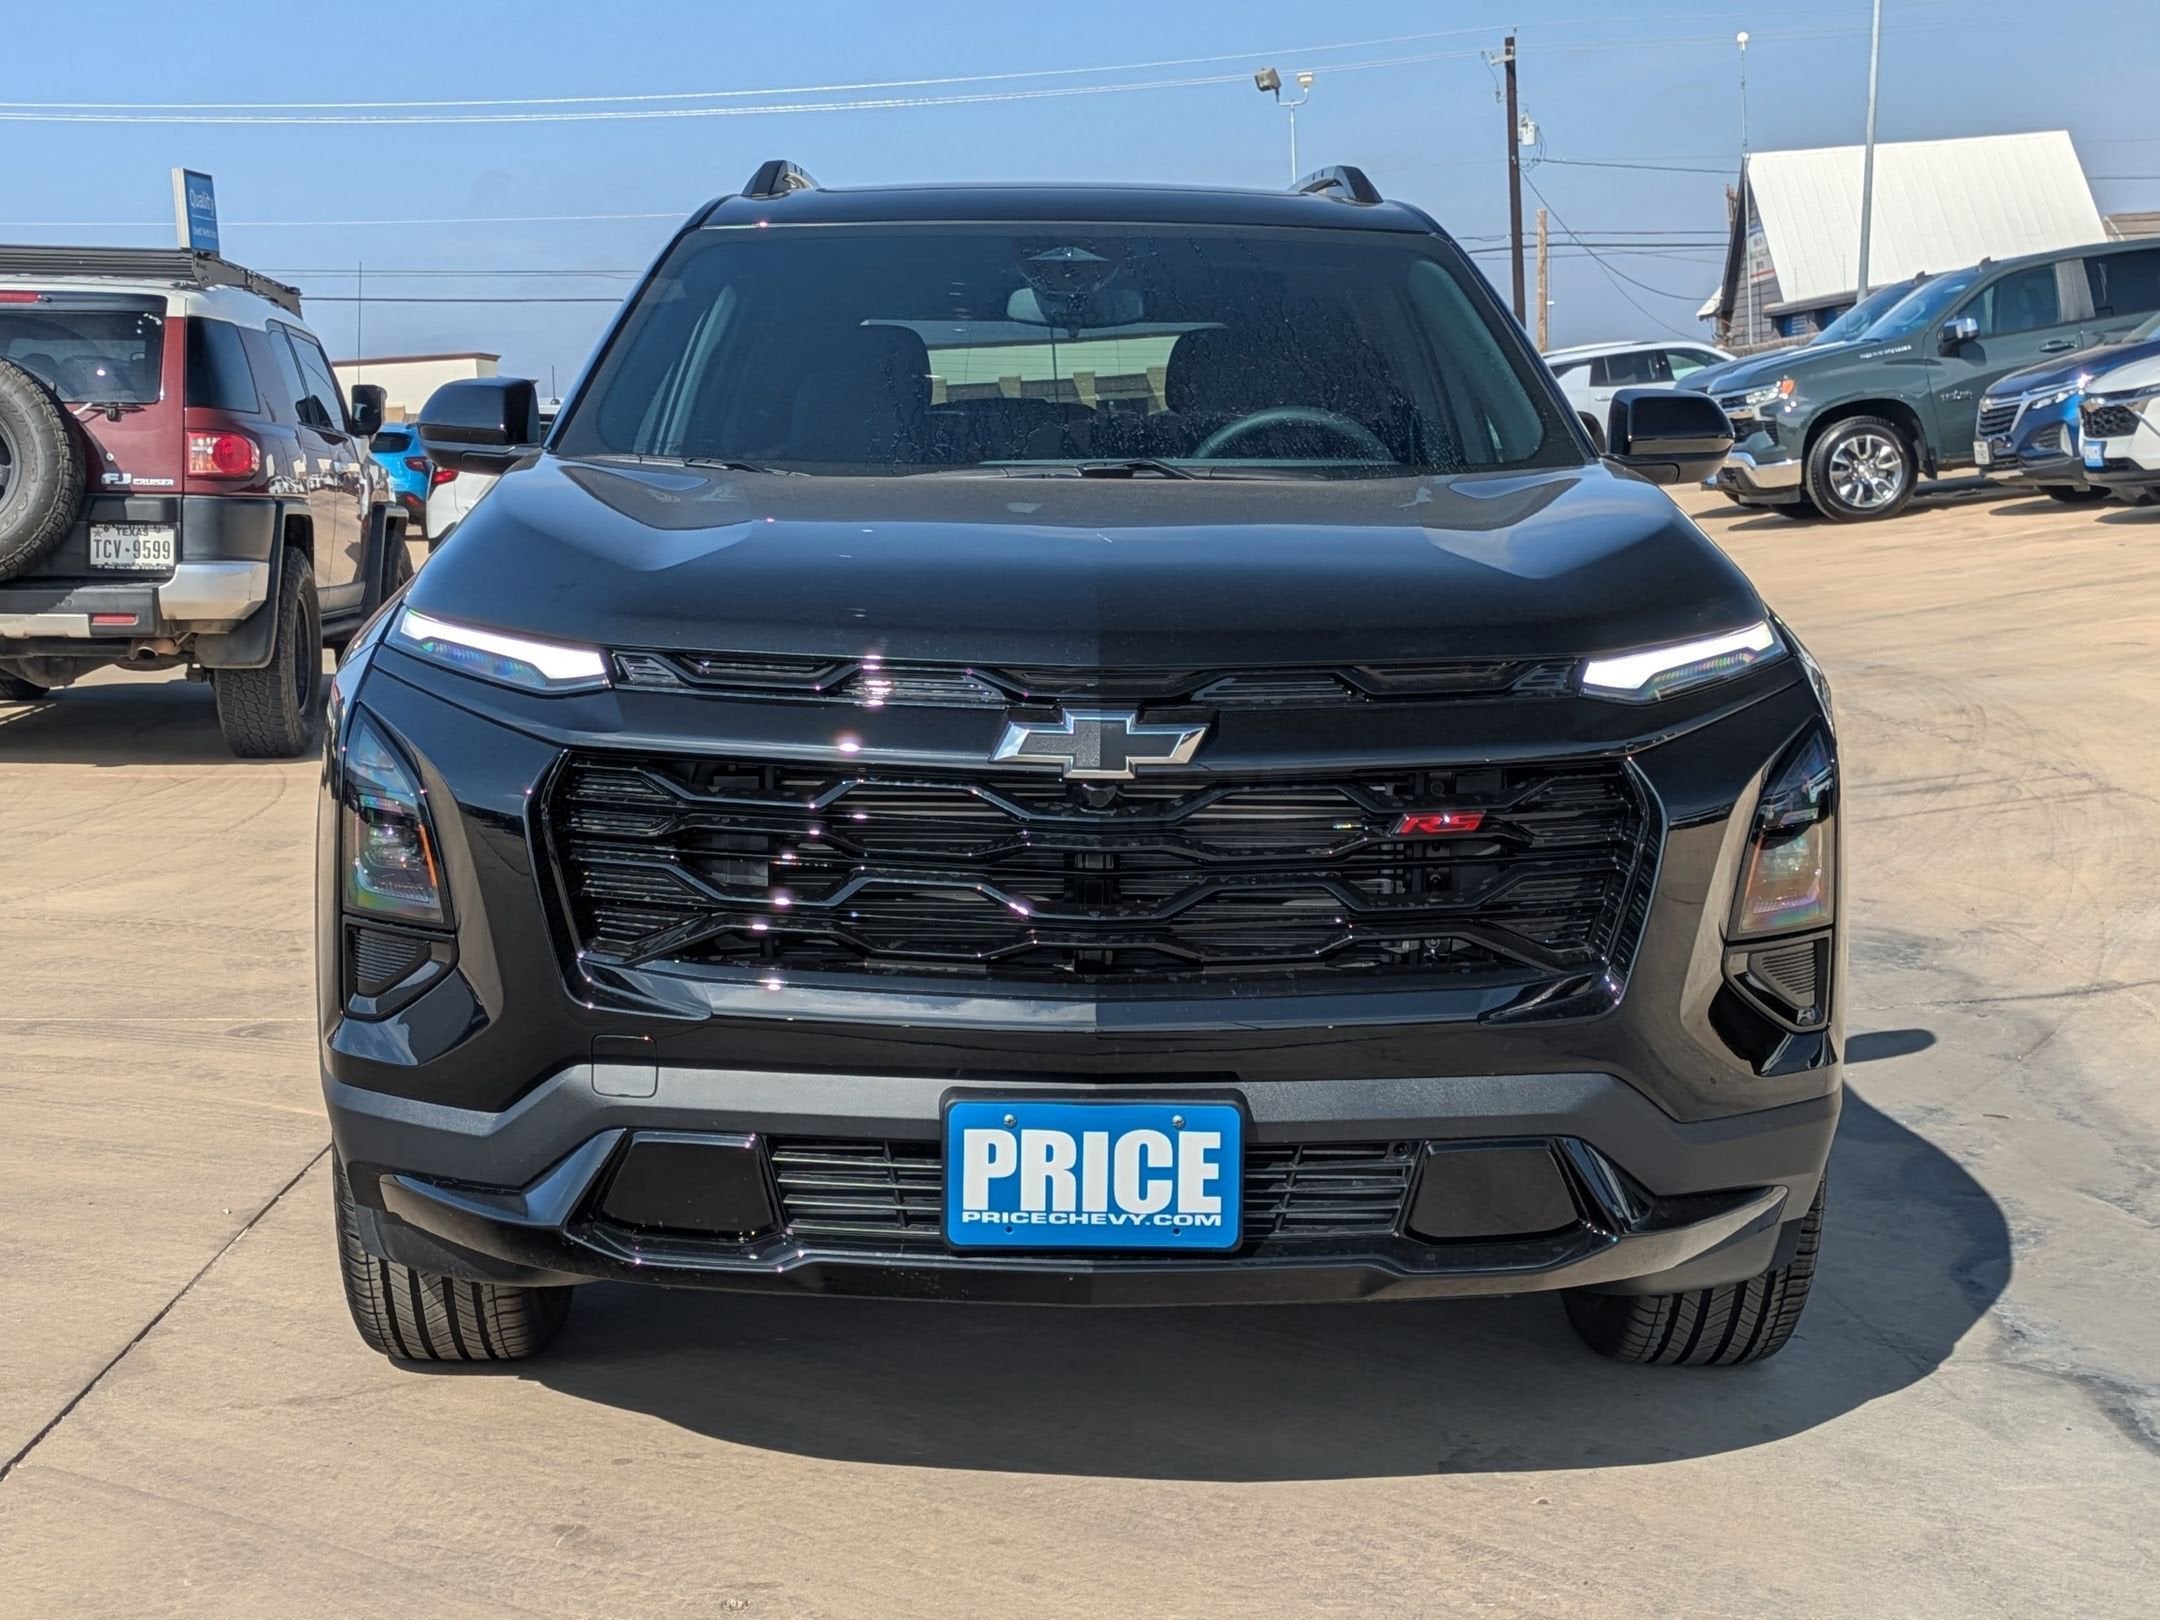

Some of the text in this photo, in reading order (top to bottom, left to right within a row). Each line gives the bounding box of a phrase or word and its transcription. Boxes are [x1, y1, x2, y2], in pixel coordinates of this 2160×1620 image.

[190, 188, 214, 217] Quality
[101, 473, 175, 486] FJ CRUISER
[117, 527, 149, 537] TEXAS
[1396, 814, 1484, 835] RS
[963, 1128, 1222, 1214] PRICE
[962, 1211, 1222, 1227] PRICECHEVY.COM
